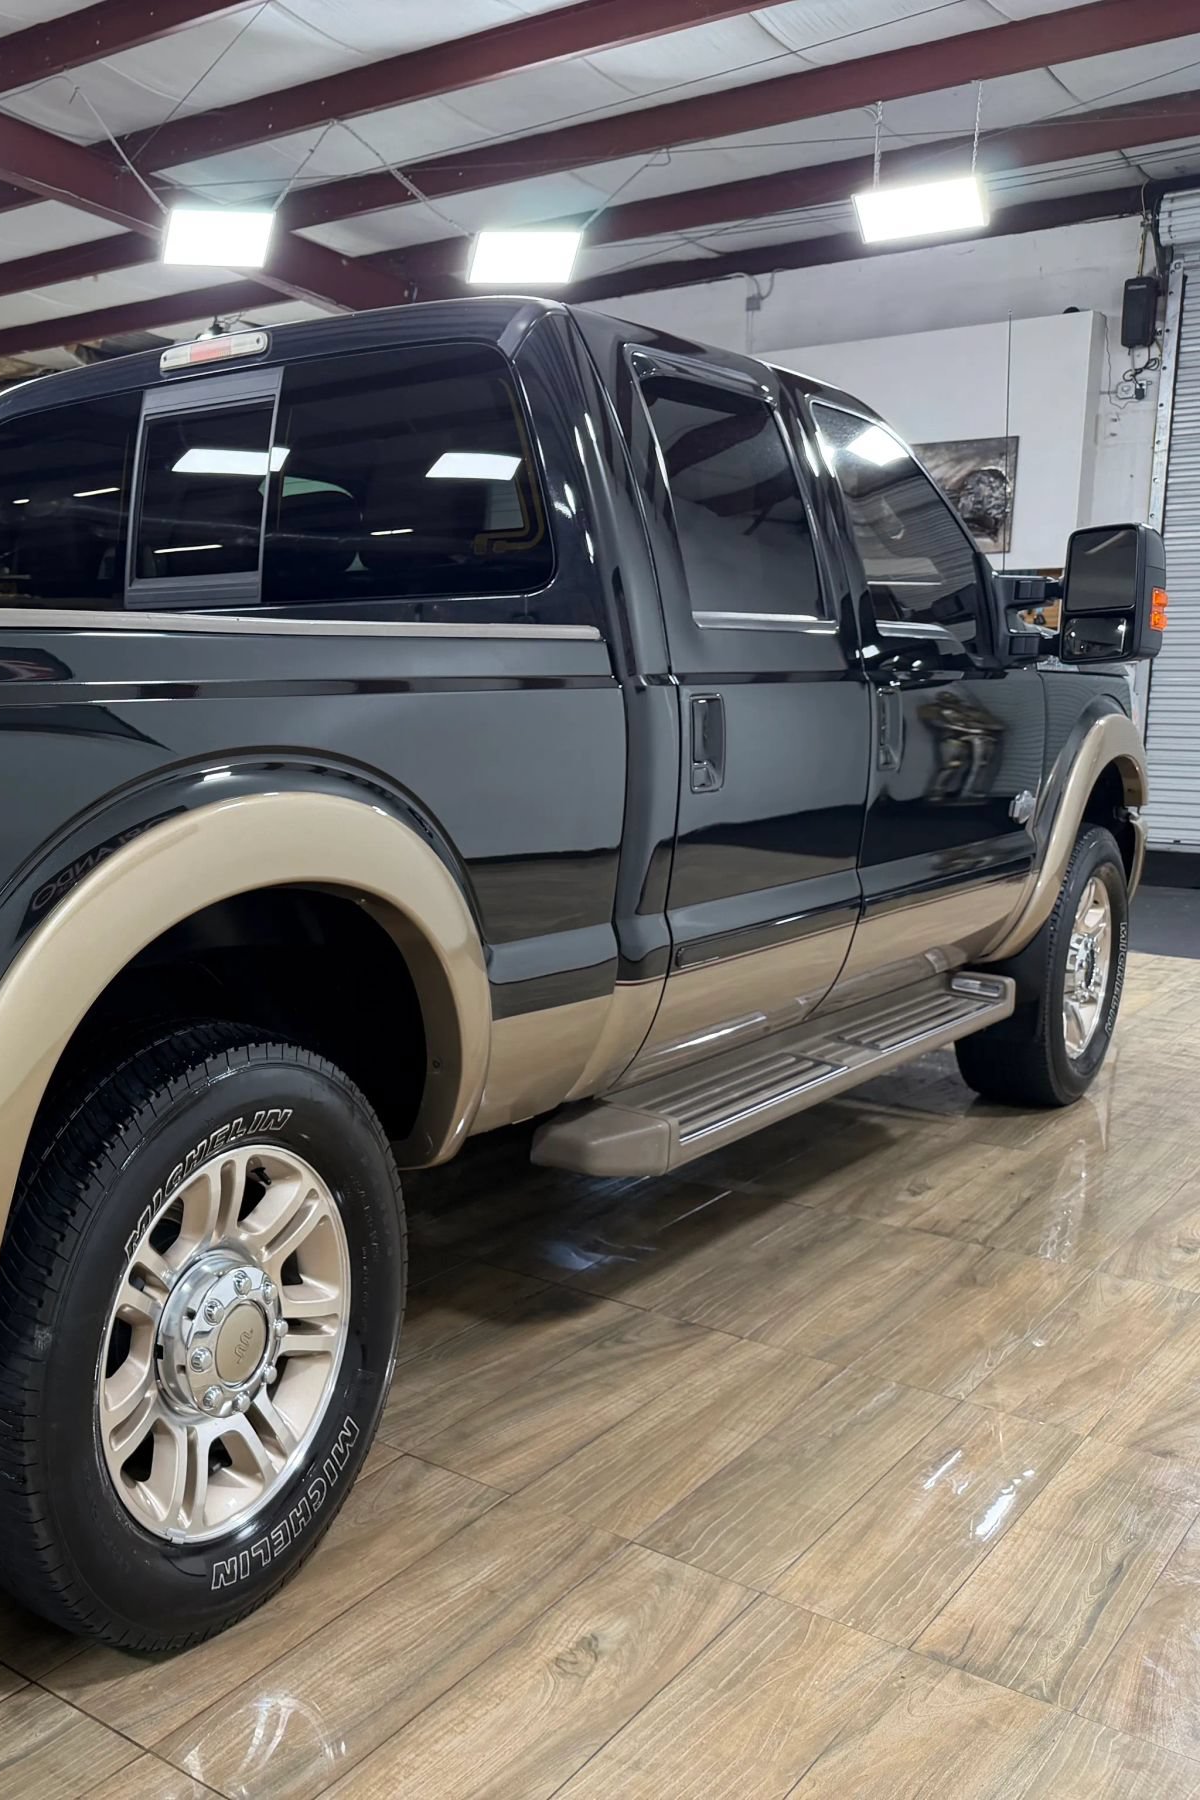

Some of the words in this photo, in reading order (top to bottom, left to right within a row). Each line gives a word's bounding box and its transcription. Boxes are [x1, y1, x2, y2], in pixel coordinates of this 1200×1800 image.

[1104, 922, 1128, 1038] MICHELIN
[124, 1108, 293, 1263] MICHELIN
[211, 1415, 360, 1591] MICHELIN
